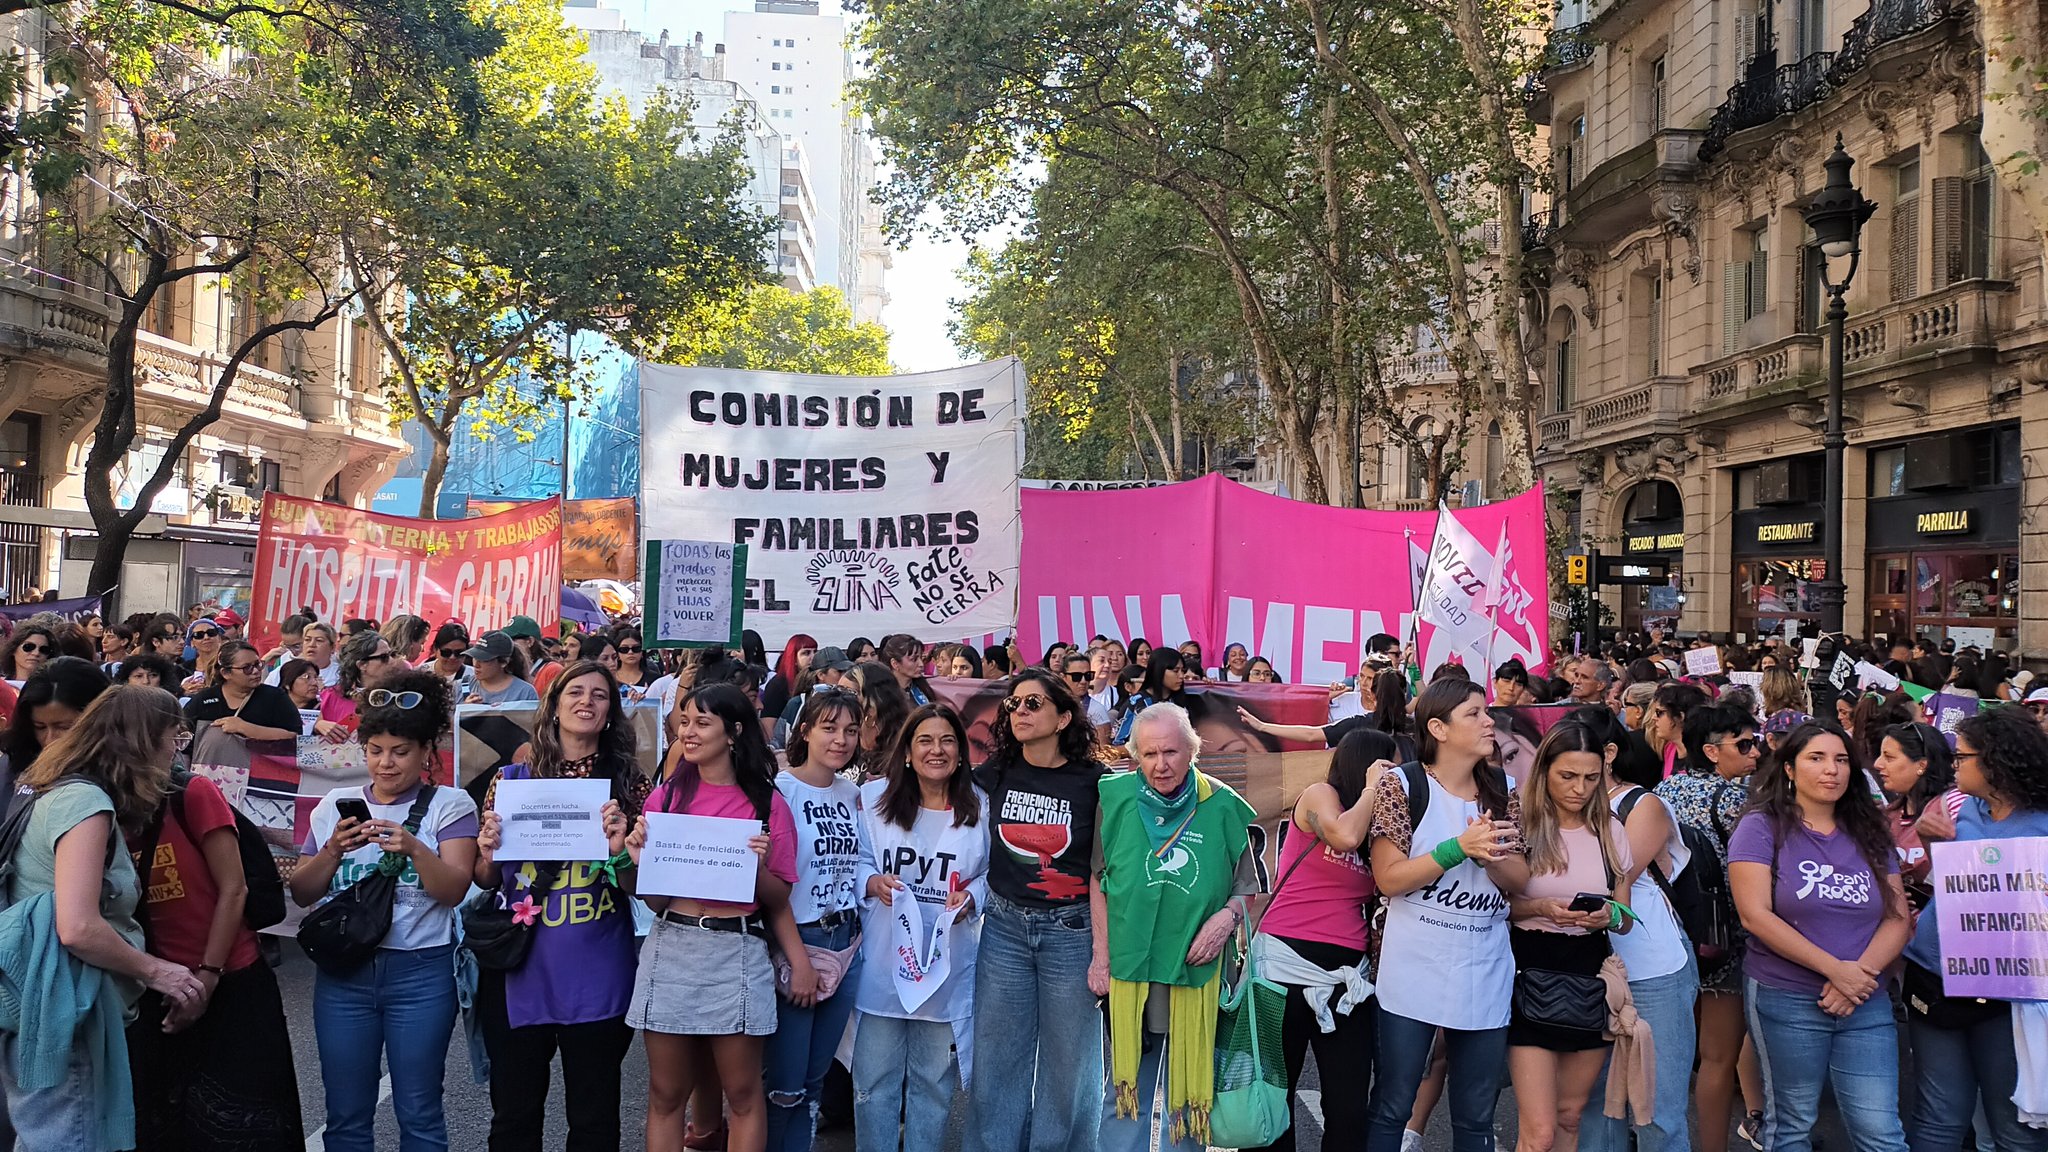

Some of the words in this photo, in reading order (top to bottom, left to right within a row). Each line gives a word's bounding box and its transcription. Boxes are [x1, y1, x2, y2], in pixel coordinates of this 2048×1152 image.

[690, 389, 914, 428] COMISIÓN
[937, 388, 987, 425] DE
[682, 452, 887, 492] MUJERES
[925, 451, 951, 485] Y
[733, 510, 980, 551] FAMILIARES
[1917, 510, 1968, 532] PARRILLA
[455, 529, 469, 550] Y
[1628, 535, 1655, 551] PESCADOS
[1656, 533, 1684, 549] MARISCOS
[1758, 522, 1815, 542] RESTAURANTE
[714, 545, 732, 560] las
[673, 563, 717, 577] madres
[675, 585, 689, 594] ver
[699, 585, 714, 594] sus
[676, 577, 713, 586] merecen
[912, 583, 944, 613] NO
[949, 565, 975, 592] SE
[677, 596, 711, 607] HIJAS
[743, 578, 791, 612] EL
[812, 573, 903, 613] SUTNA
[673, 609, 715, 622] VOLVER
[1005, 789, 1059, 811] FRENEMOS
[1059, 799, 1072, 813] EL
[1001, 802, 1073, 826] GENOCIDIO
[815, 821, 837, 837] NO
[836, 822, 856, 837] SE
[655, 840, 682, 849] Basta
[698, 844, 746, 855] femicidios
[813, 836, 859, 857] CIERRA
[707, 858, 719, 867] de
[721, 860, 744, 869] odio.
[882, 846, 957, 885] APyT
[1945, 873, 2001, 894] NUNCA
[2005, 868, 2048, 892] MÁS
[541, 887, 617, 928] UBA
[1419, 915, 1468, 932] Asociación
[1960, 912, 2048, 933] INFANCIAS
[1947, 957, 1991, 976] BAJO
